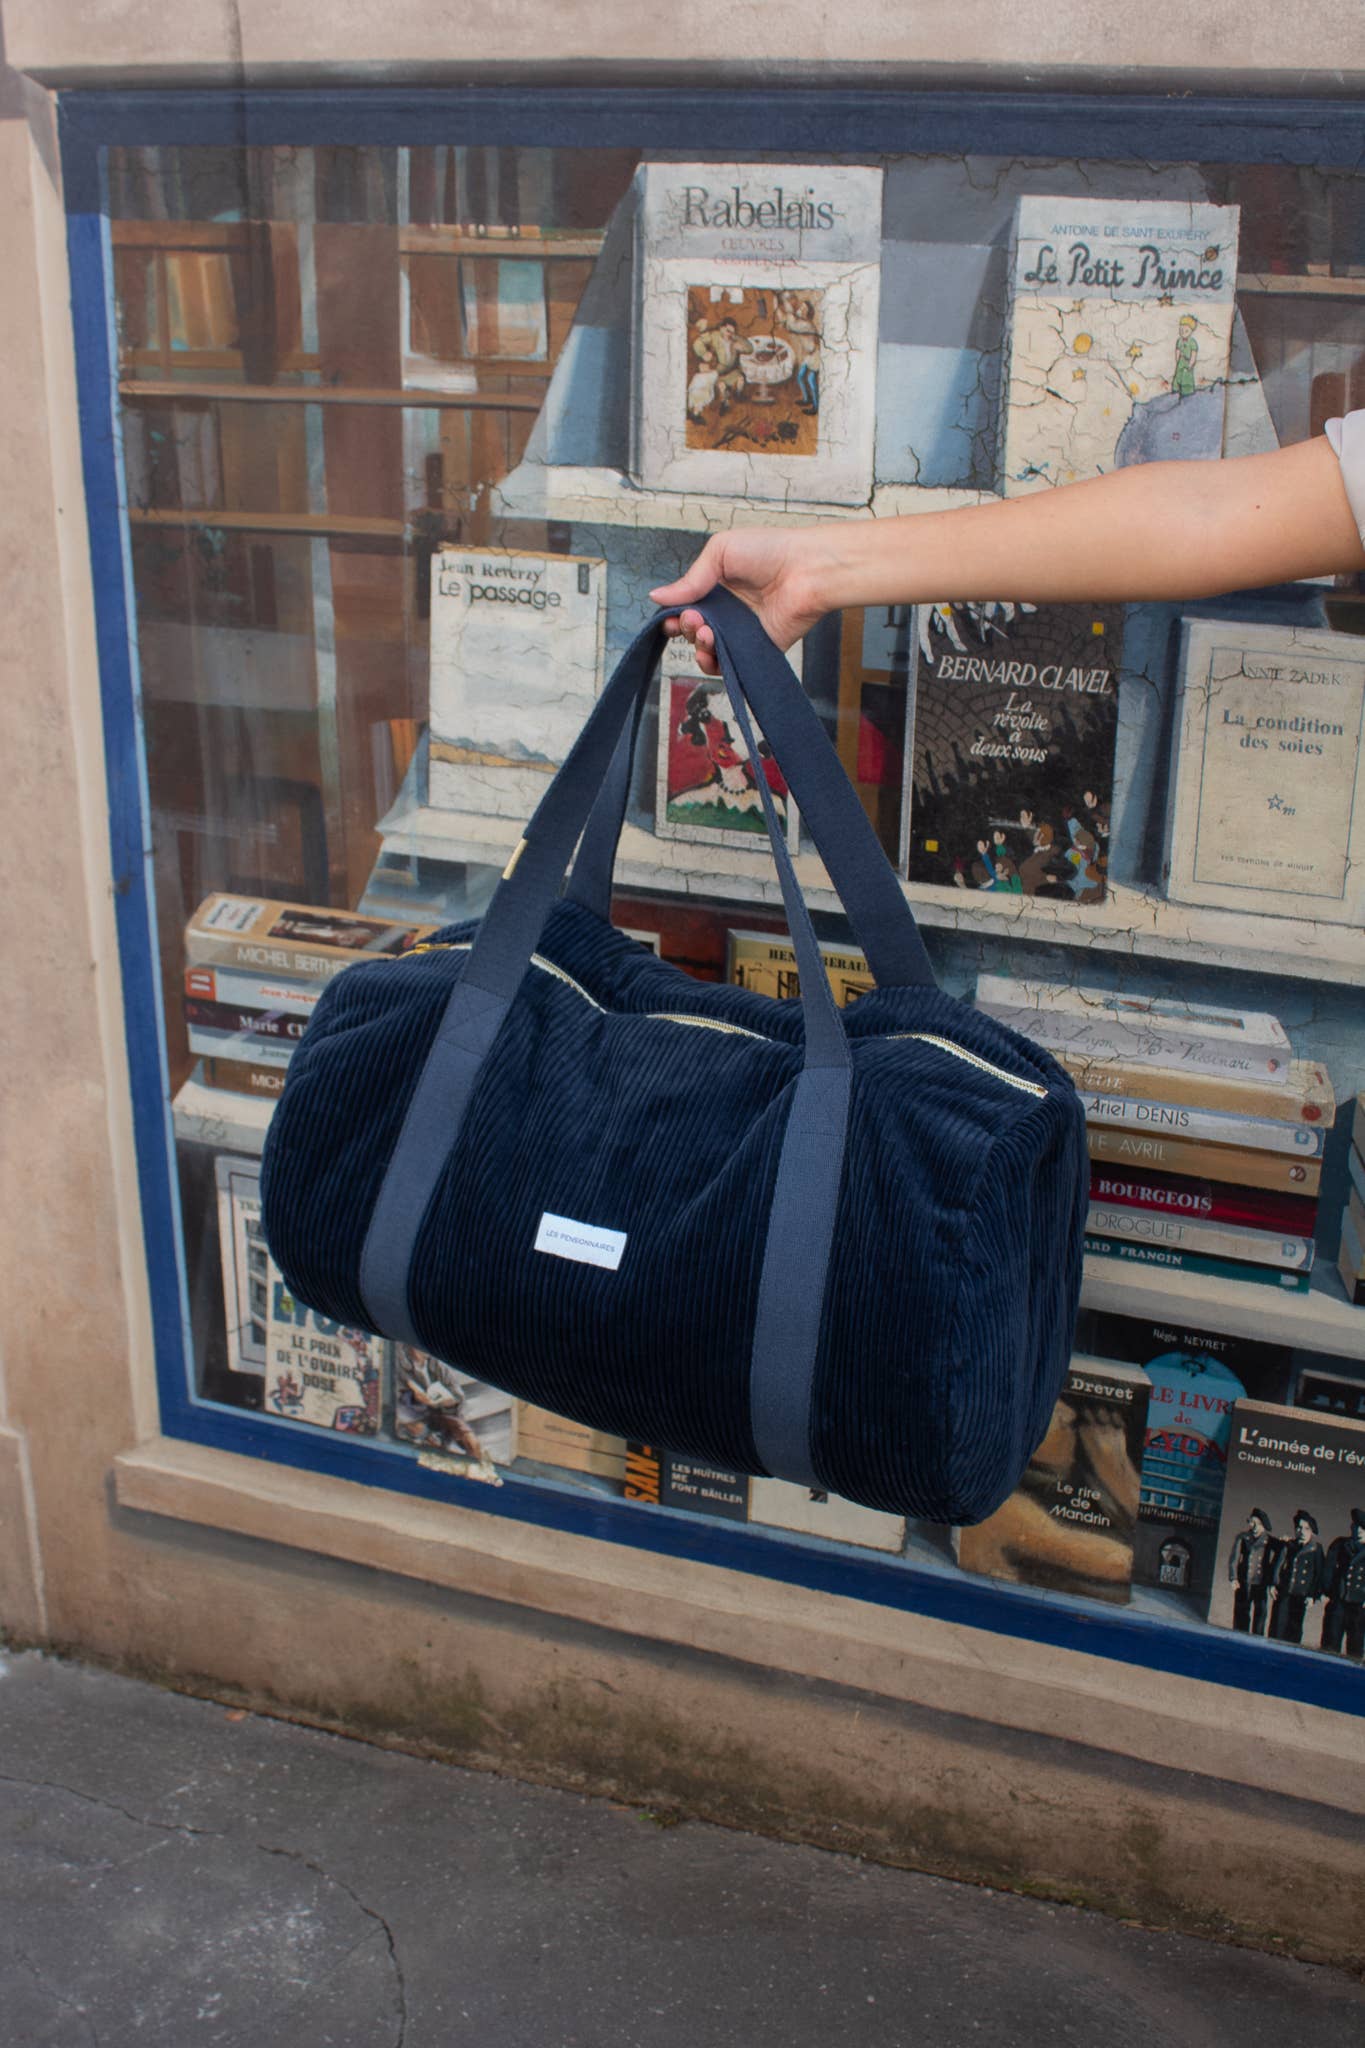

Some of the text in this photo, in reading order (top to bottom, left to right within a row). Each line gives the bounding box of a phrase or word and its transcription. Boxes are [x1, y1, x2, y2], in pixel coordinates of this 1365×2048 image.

[682, 186, 835, 230] Rabelais
[1051, 223, 1100, 237] ANTOINE
[1103, 226, 1119, 238] DE
[1122, 226, 1154, 239] SAINT
[1024, 242, 1224, 290] Le Petit Prince
[439, 576, 562, 611] Le passage
[937, 655, 1114, 694] BERNARD CLAVEL
[1289, 669, 1342, 685] ZADEK
[1004, 692, 1033, 712] La
[993, 711, 1049, 731] révolte
[1222, 709, 1345, 736] La condition
[970, 736, 1048, 762] deux sous
[1239, 734, 1324, 755] des soies
[237, 946, 290, 969] MICHEL
[239, 1015, 280, 1033] Marie
[1087, 1096, 1190, 1127] Ariel DENIS
[1119, 1139, 1167, 1161] AVRIL
[1098, 1179, 1213, 1211] BOURGEOIS
[1095, 1212, 1185, 1240] DROGUET
[1120, 1246, 1183, 1265] FRANGIN
[292, 1334, 342, 1358] LE PRIX
[1184, 1335, 1226, 1351] NEYRET
[276, 1350, 292, 1364] DE
[1071, 1377, 1135, 1401] Drevet
[1150, 1385, 1234, 1416] LE LIVR
[1174, 1411, 1193, 1425] de
[1144, 1427, 1229, 1464] LYON
[1239, 1426, 1365, 1467] L'année de l'év
[671, 1462, 691, 1475] LES
[1238, 1450, 1317, 1474] Charles Juliet
[671, 1472, 688, 1483] ME
[671, 1481, 698, 1495] FONT
[1056, 1480, 1101, 1500] Le rire
[1070, 1496, 1091, 1509] de
[1049, 1504, 1111, 1527] Mandrin
